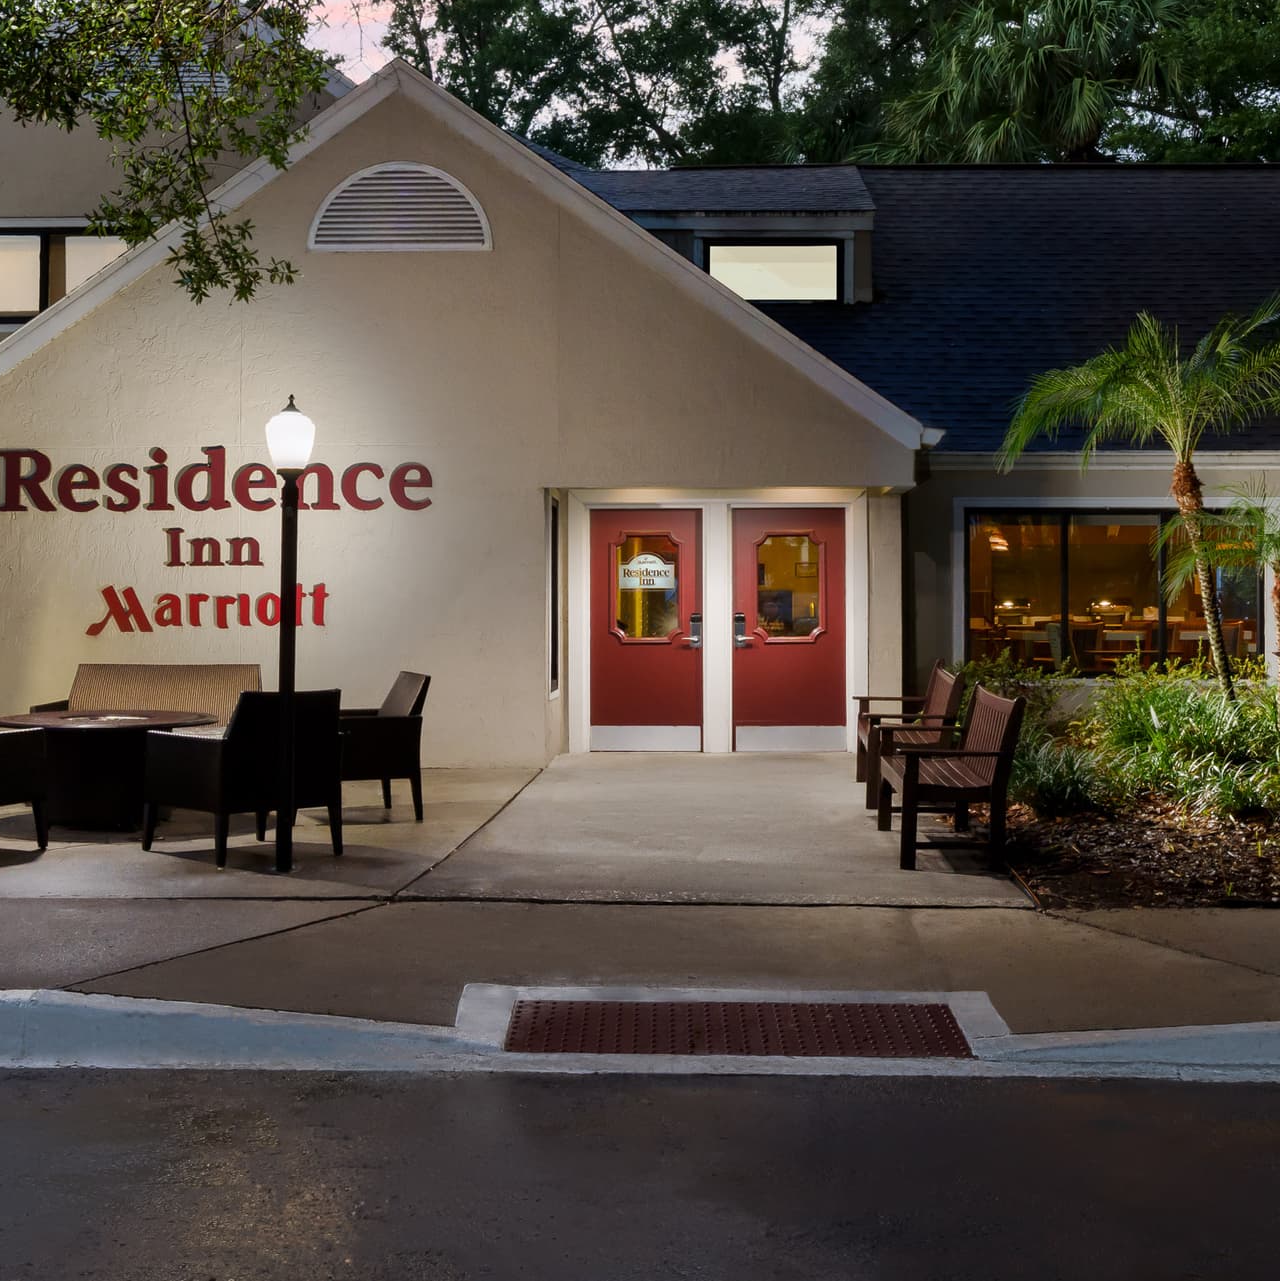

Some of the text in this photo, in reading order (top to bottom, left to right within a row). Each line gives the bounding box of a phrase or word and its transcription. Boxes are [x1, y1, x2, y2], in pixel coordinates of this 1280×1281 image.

[163, 527, 264, 567] Inn
[623, 568, 670, 578] Residence
[640, 577, 655, 585] Inn
